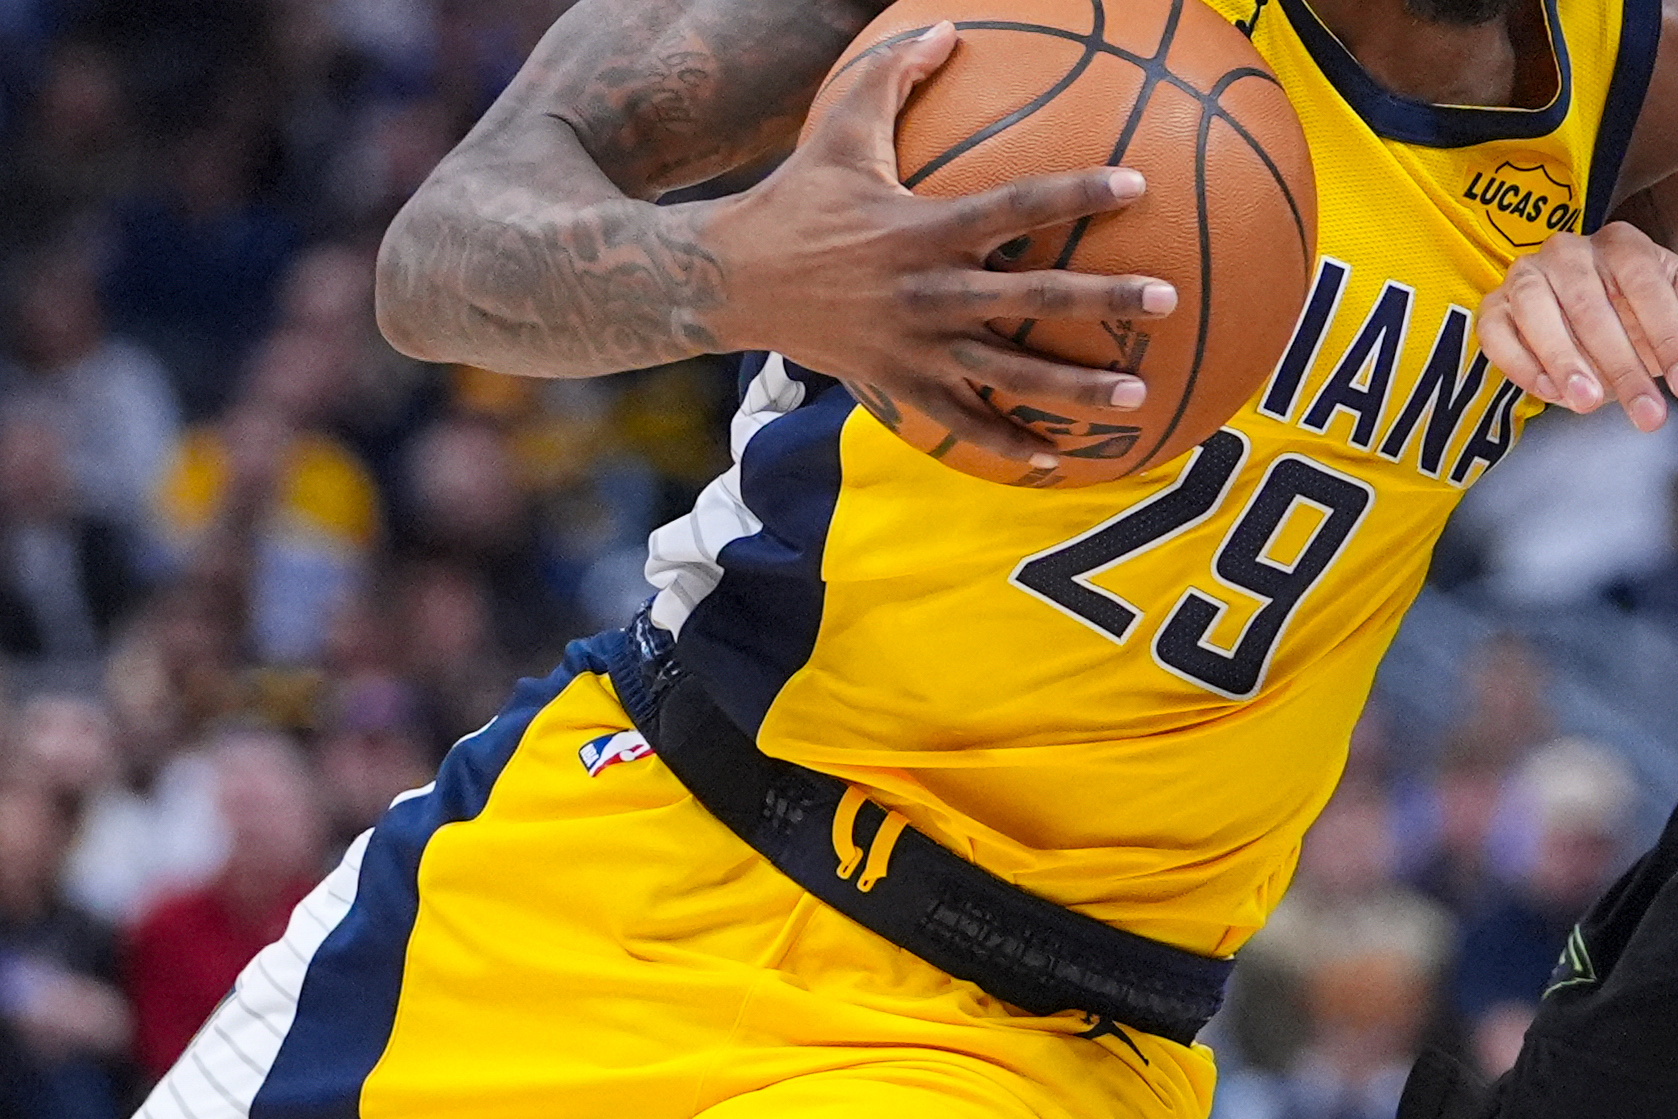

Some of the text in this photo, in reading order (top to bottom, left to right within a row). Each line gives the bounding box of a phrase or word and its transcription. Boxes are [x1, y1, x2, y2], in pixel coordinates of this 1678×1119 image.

[1463, 172, 1548, 222] LUCAS
[1259, 256, 1525, 490] IANA
[1008, 426, 1376, 701] 29
